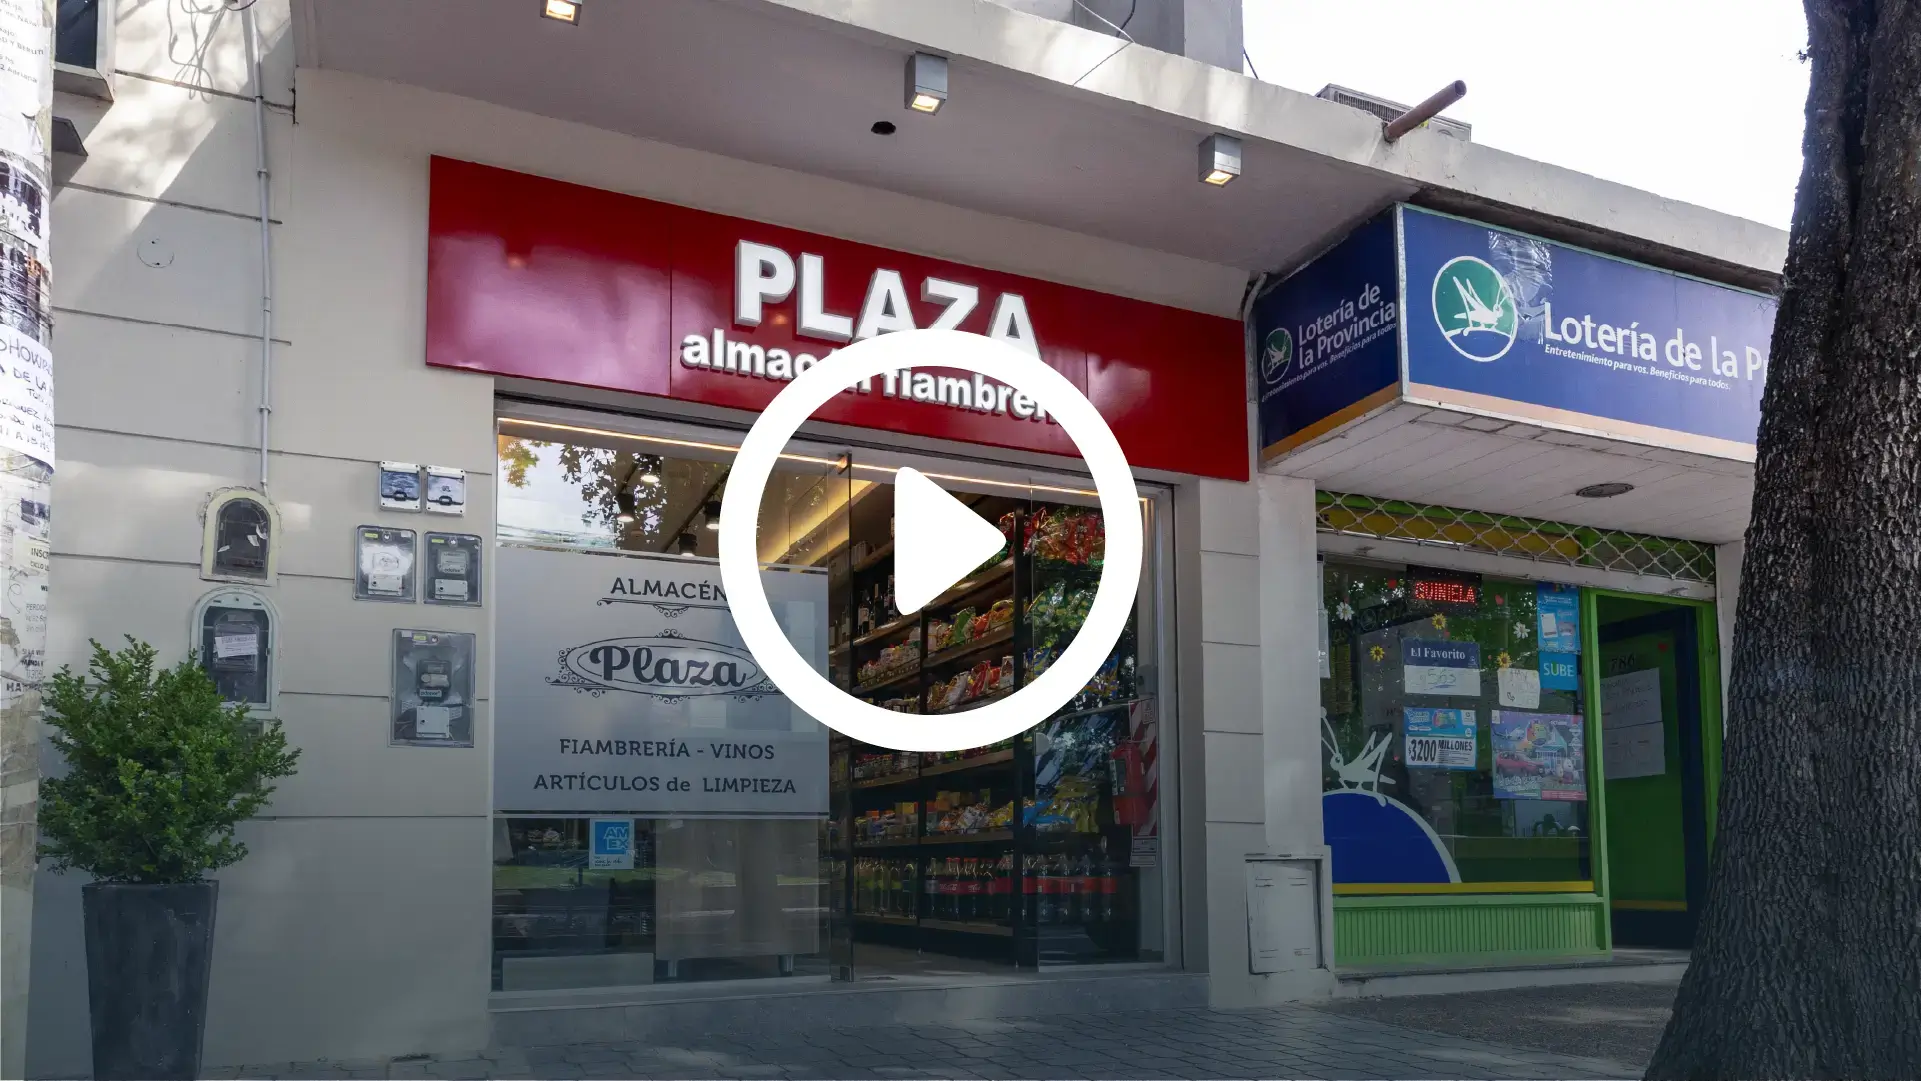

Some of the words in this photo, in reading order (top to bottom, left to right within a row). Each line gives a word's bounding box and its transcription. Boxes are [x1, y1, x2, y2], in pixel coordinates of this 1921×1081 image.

[735, 239, 1042, 360] PLAZA
[1299, 299, 1355, 346] Lotería
[1358, 283, 1380, 310] de
[1299, 346, 1314, 369] la
[1318, 301, 1395, 359] Provincia
[1544, 301, 1657, 362] Lotería
[1665, 328, 1702, 371] de
[1711, 336, 1738, 378] la
[1545, 344, 1613, 368] Entretenimiento
[1613, 360, 1632, 373] para
[1633, 364, 1649, 375] vos.
[1650, 366, 1689, 383] Beneficios
[1689, 375, 1708, 387] para
[1708, 378, 1731, 390] todos.
[611, 577, 728, 601] ALMACÉN
[1415, 582, 1475, 603] QUINIELA
[1410, 647, 1421, 657] El
[1424, 647, 1466, 660] Favorito
[589, 645, 746, 687] Plaza
[1543, 662, 1575, 677] SUBE
[559, 738, 690, 758] FIAMBRERÍA
[709, 743, 775, 760] VINOS
[1438, 739, 1473, 752] MILLONES
[533, 771, 660, 792] ARTÍCULOS
[666, 776, 691, 792] de
[702, 776, 797, 794] LIMPIEZA
